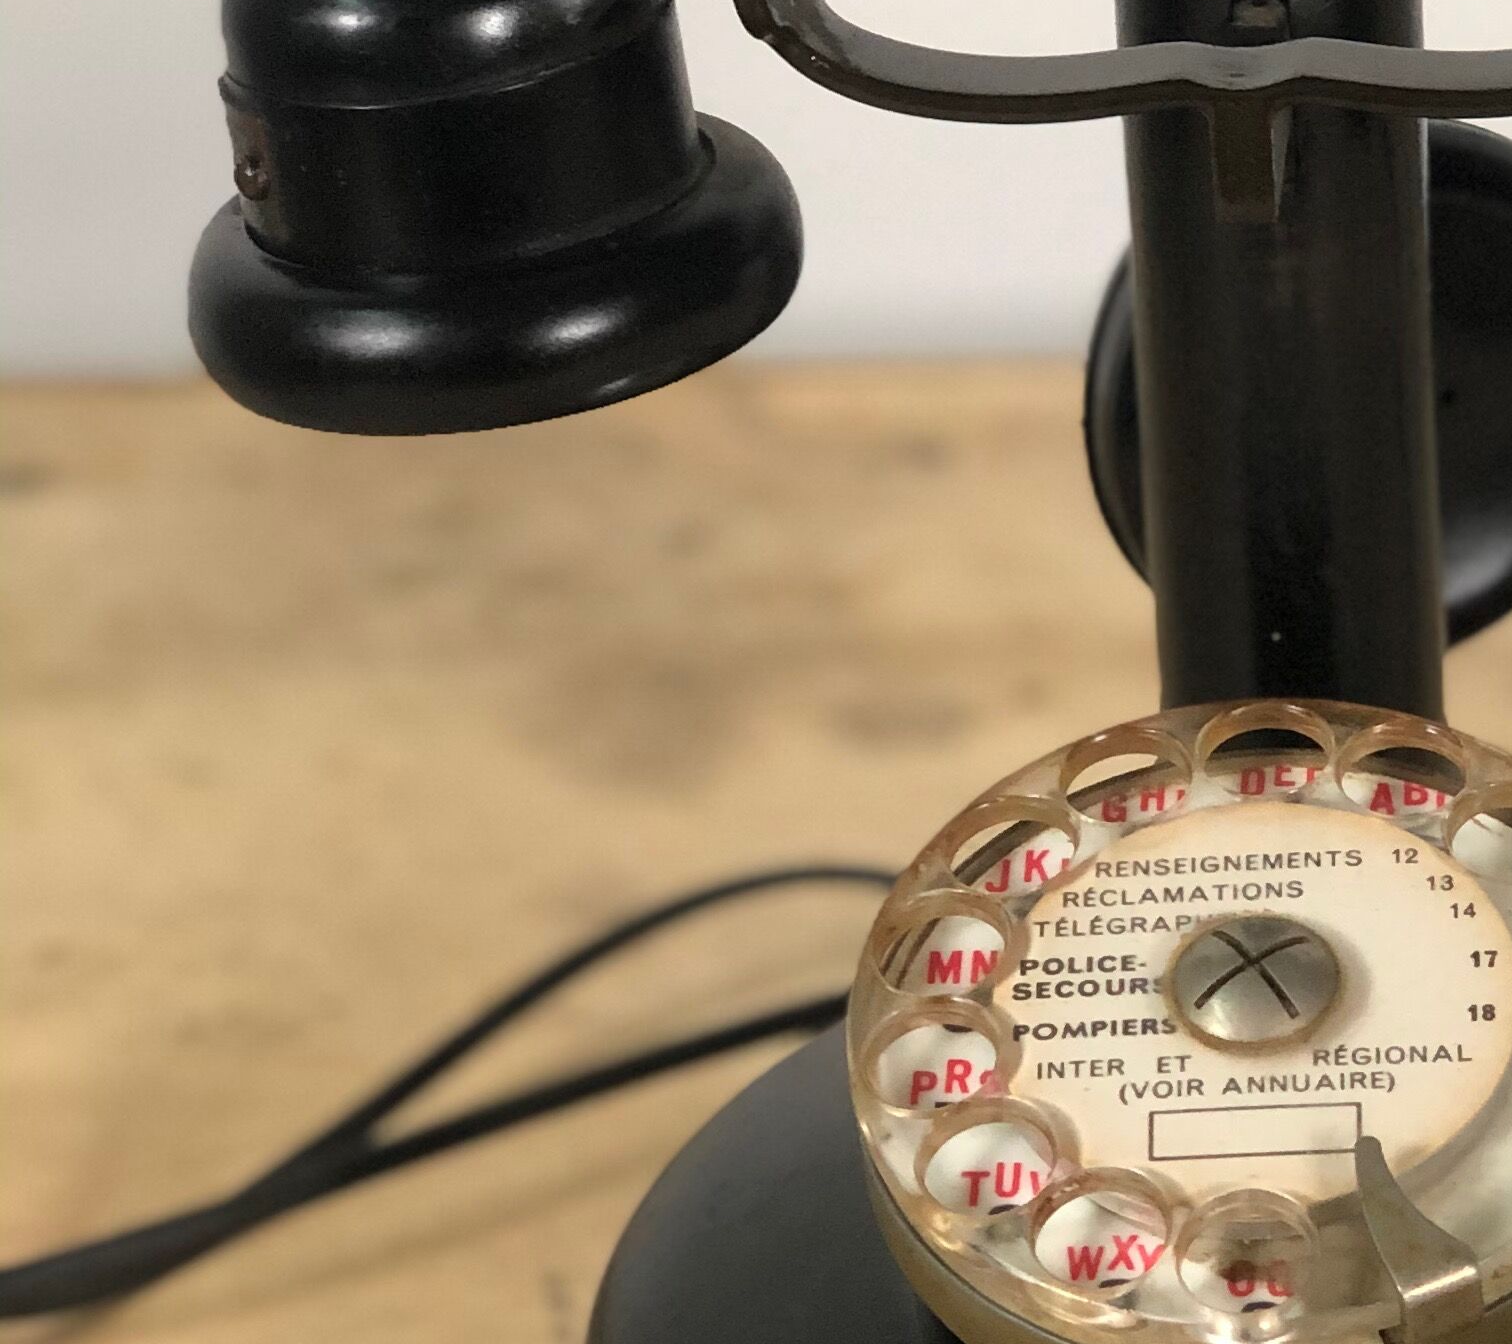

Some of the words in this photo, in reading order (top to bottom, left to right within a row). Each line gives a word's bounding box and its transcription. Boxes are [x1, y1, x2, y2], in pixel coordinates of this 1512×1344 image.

[985, 849, 1071, 893] JK
[1095, 849, 1364, 879] RENSEIGNEMENTS
[1392, 847, 1419, 865] 12
[1062, 880, 1305, 909] RÉCLAMATIONS
[1426, 874, 1455, 892] 13
[1033, 913, 1198, 938] TÉLÉGRAP
[1450, 902, 1477, 920] 14
[1019, 954, 1147, 977] POLICE-
[1469, 950, 1499, 969] 17
[1012, 1017, 1177, 1042] POMPIERS
[1467, 1003, 1497, 1023] 18
[1036, 1057, 1125, 1081] INTER
[1156, 1055, 1192, 1075] ET
[1312, 1043, 1474, 1067] RÉGIONAL
[1118, 1077, 1205, 1107] (VOIR
[1222, 1070, 1396, 1095] ANNUAIRE)
